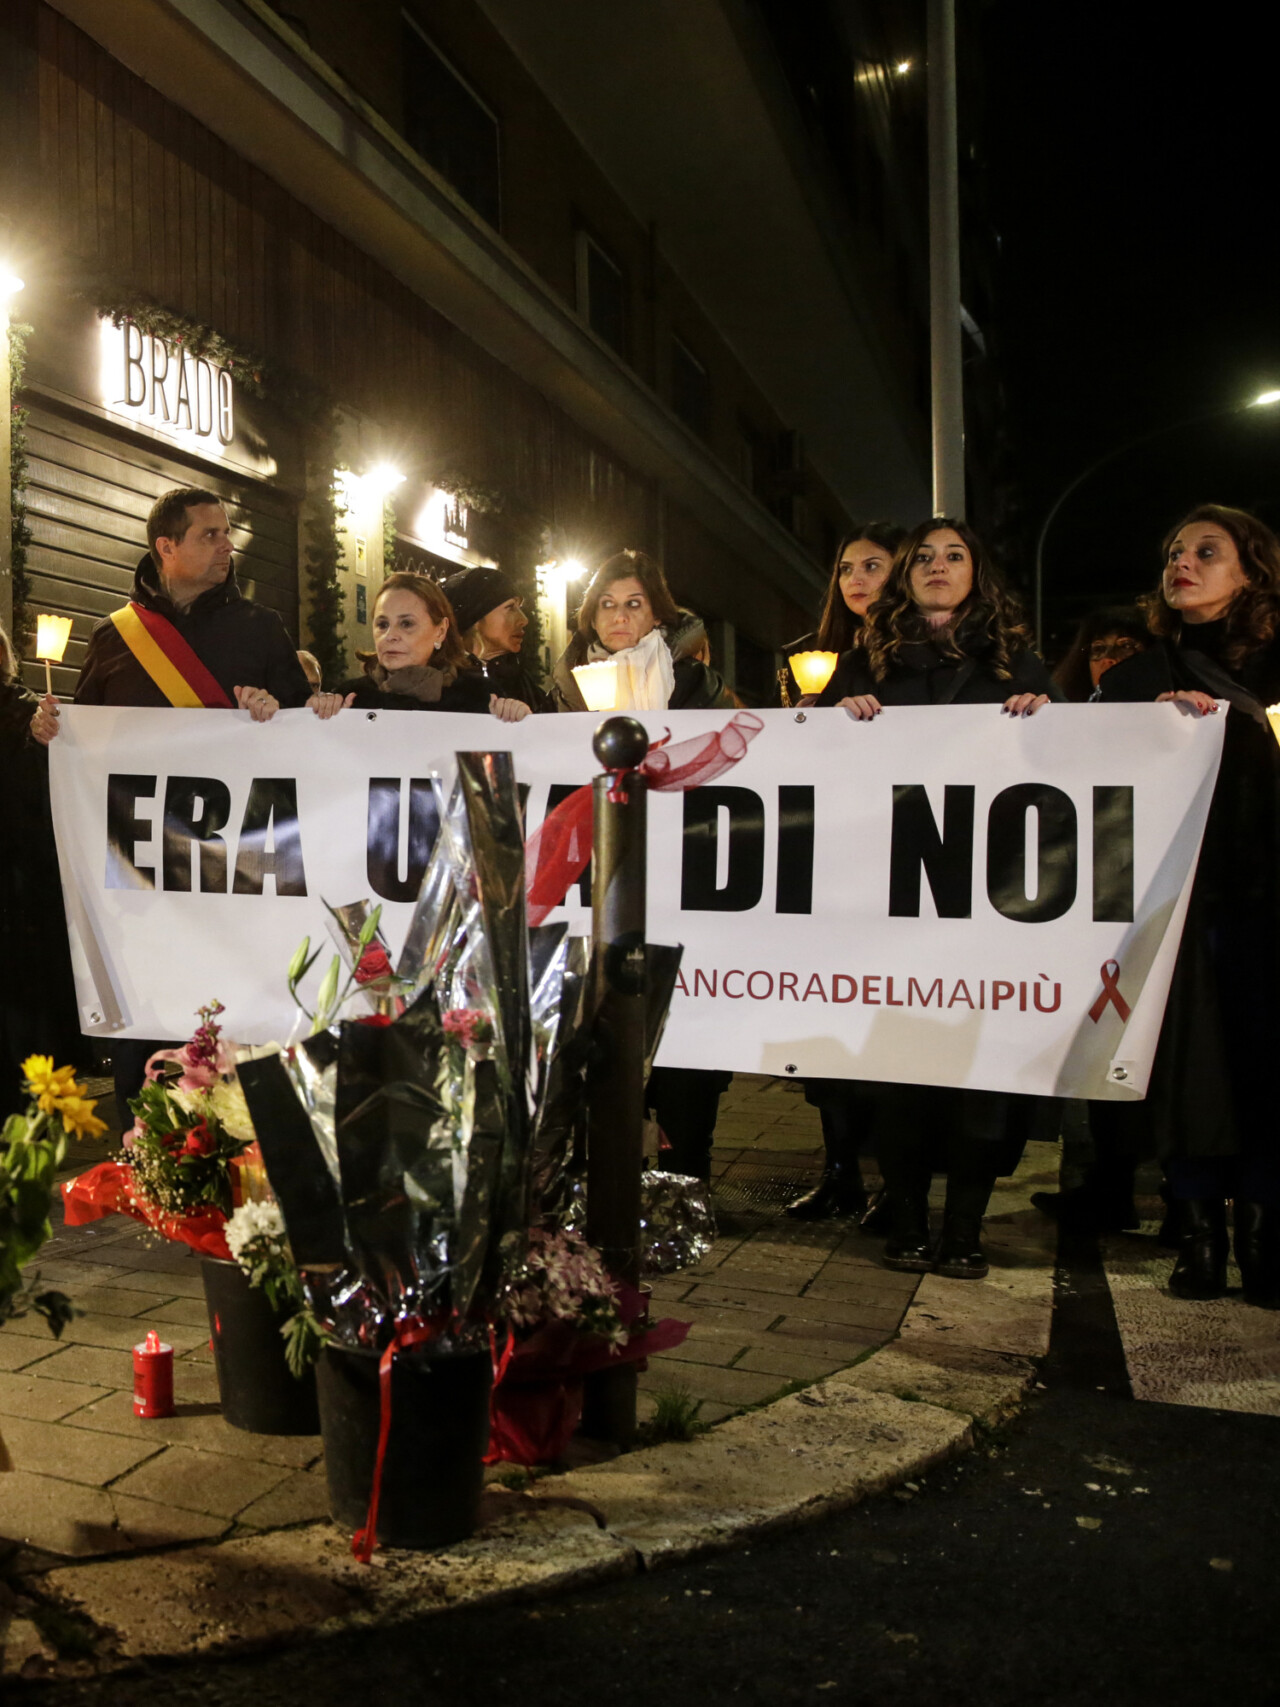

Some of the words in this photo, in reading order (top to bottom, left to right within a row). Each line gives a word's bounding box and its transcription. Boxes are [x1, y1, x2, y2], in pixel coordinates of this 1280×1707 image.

[124, 318, 235, 447] BRADO
[104, 773, 308, 897] ERA
[366, 776, 593, 908] UA
[680, 784, 815, 915] DI
[888, 782, 1135, 923] NOI
